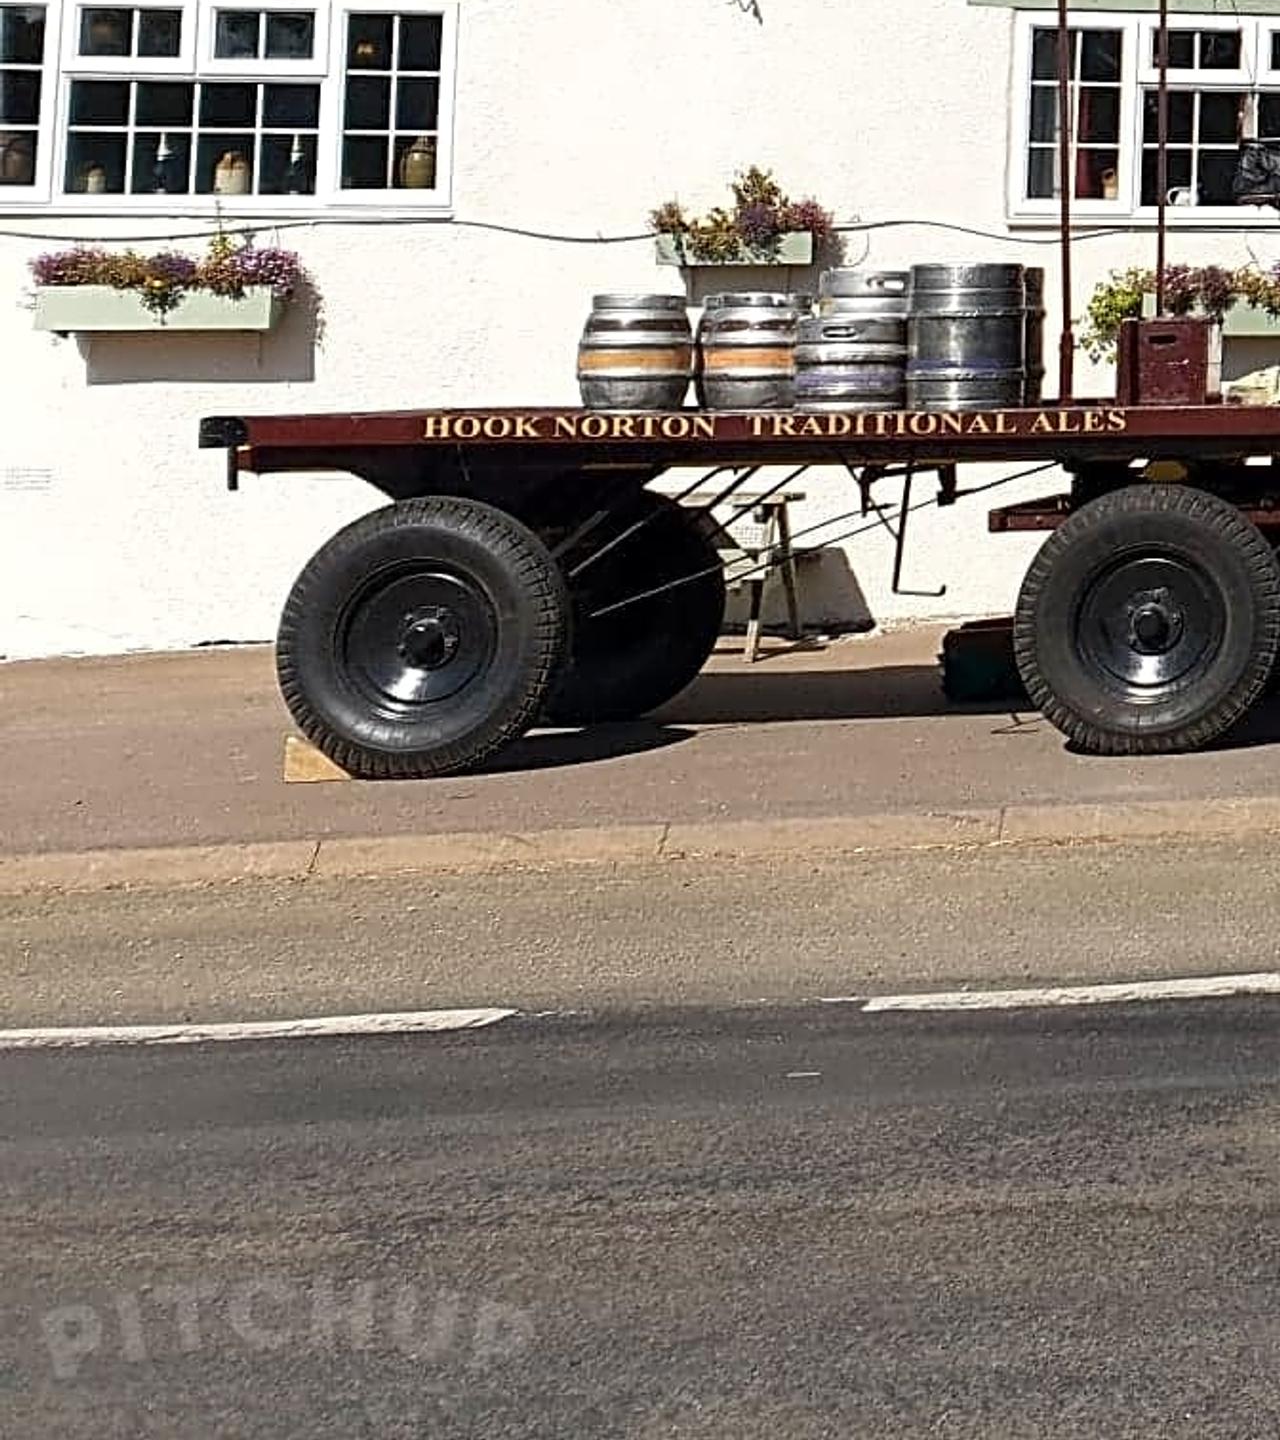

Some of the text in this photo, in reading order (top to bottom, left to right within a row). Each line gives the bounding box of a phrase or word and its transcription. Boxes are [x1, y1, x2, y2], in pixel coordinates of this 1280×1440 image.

[423, 409, 1128, 438] HOOK NORTON TRADITIONAL ALES
